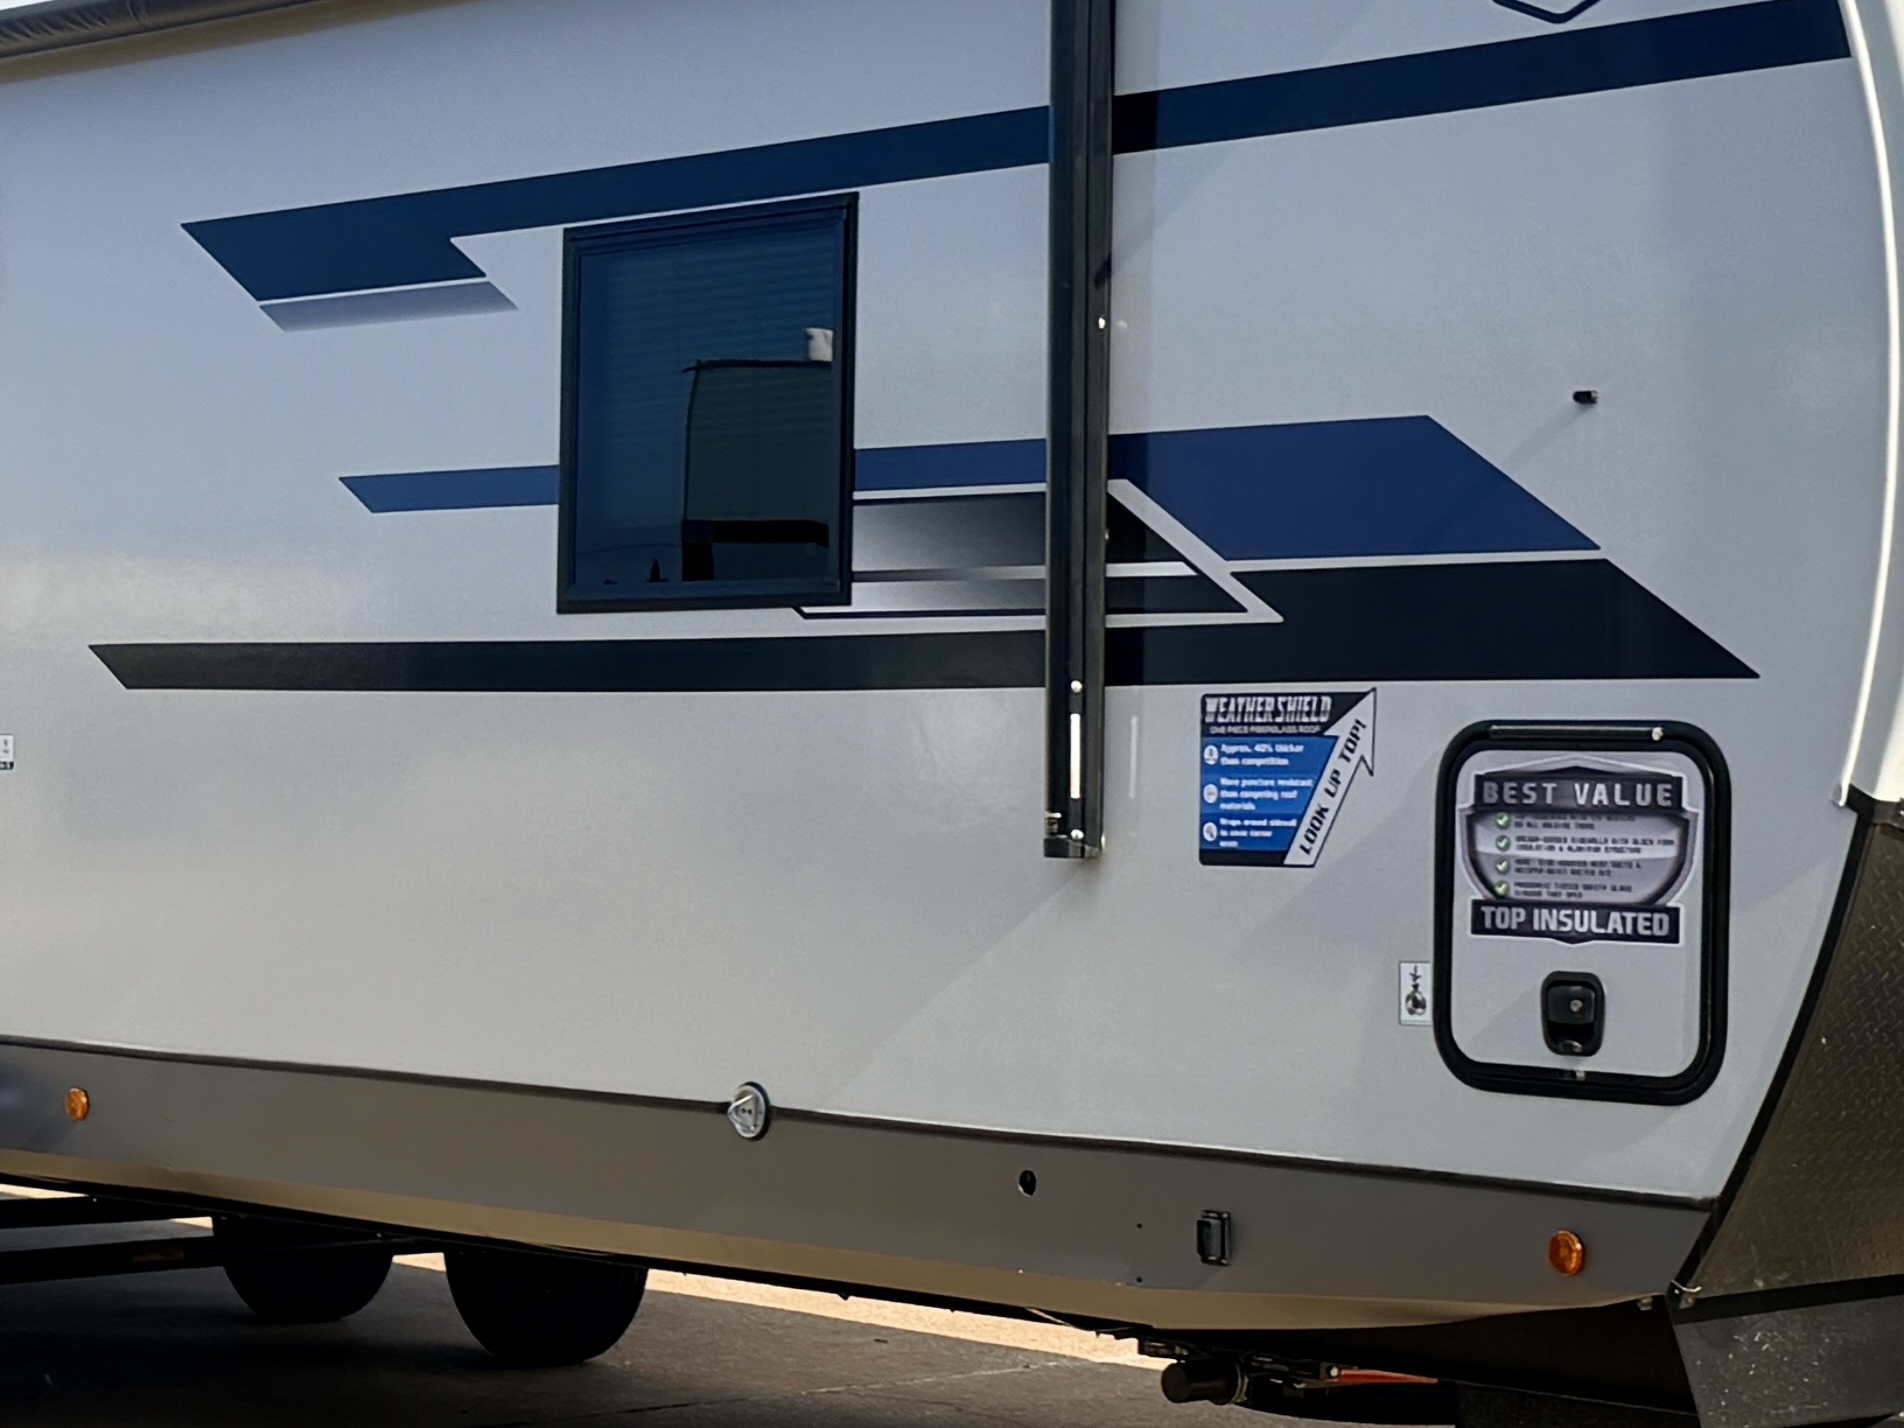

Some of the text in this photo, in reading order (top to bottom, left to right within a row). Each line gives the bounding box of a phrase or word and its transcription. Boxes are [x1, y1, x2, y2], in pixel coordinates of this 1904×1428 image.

[1299, 718, 1367, 855] LOOK UP TOP!
[1482, 781, 1673, 807] BEST VALUE
[1481, 905, 1670, 937] TOP INSULATED
